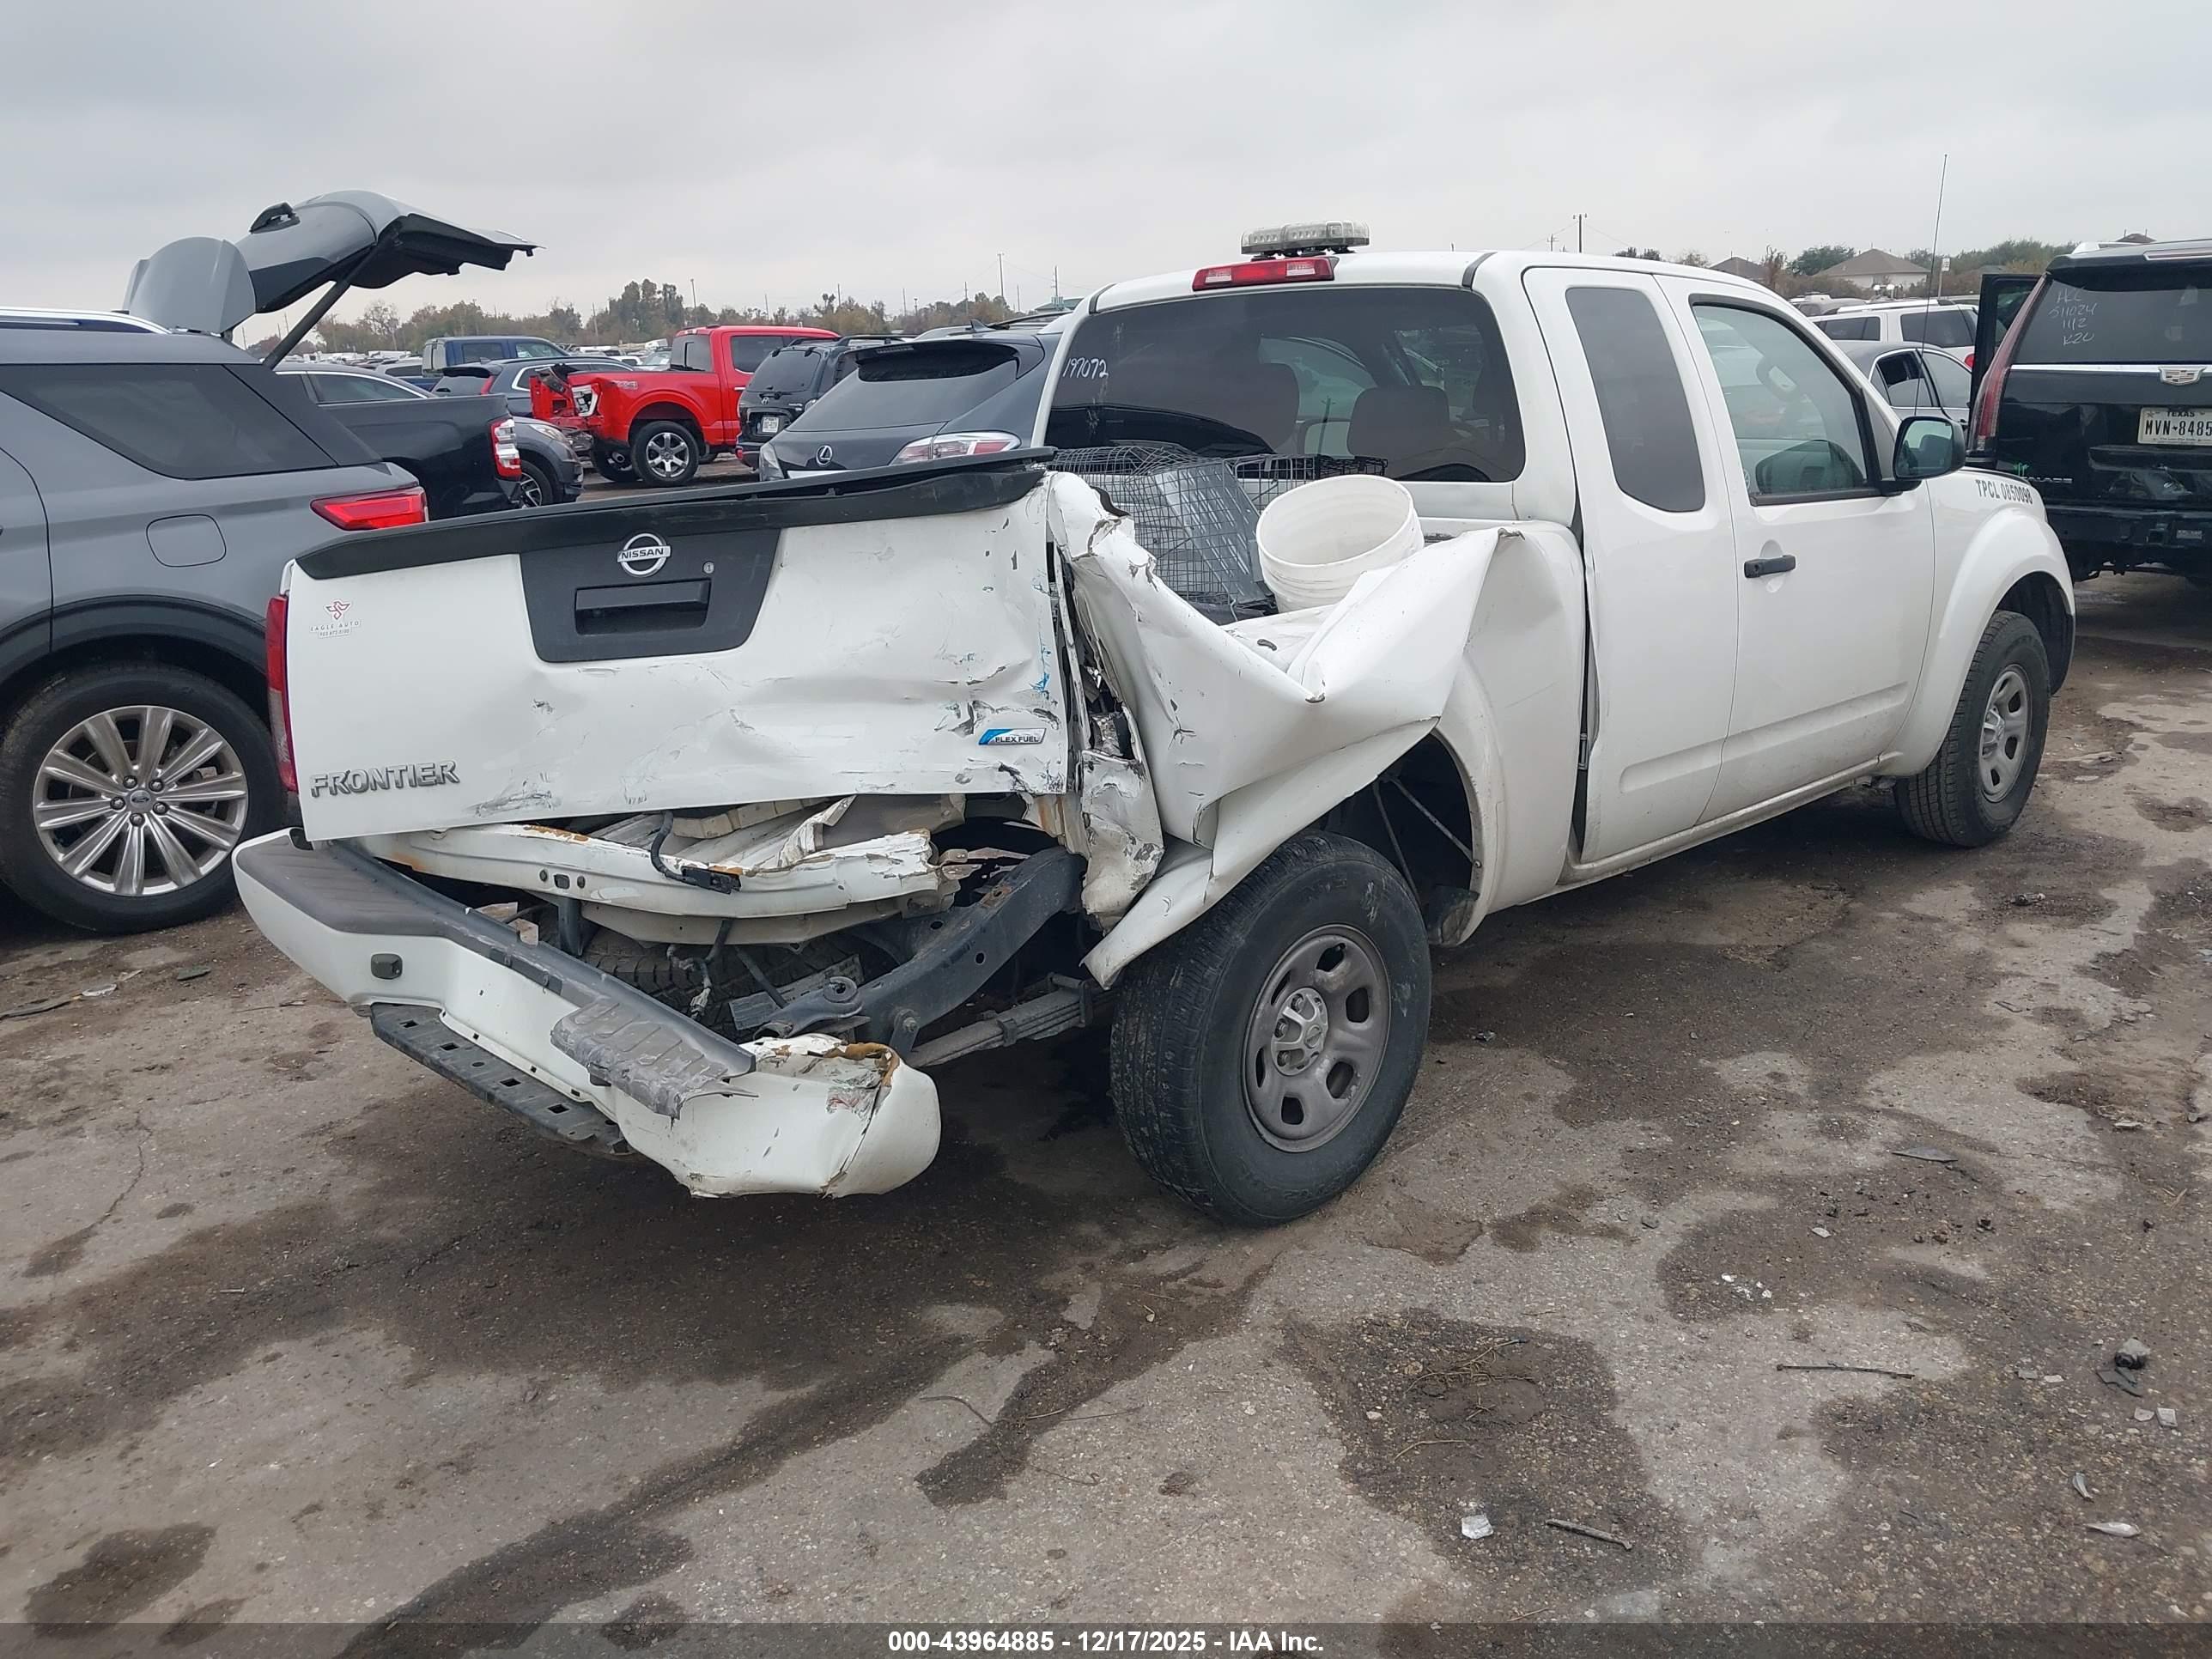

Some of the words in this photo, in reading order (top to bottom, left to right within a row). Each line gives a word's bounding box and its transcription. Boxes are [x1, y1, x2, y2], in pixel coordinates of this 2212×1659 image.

[1062, 356, 1109, 379] 197072
[1975, 479, 2001, 499] TPCL
[621, 547, 665, 559] NISSAN
[310, 759, 460, 798] FRONTIER
